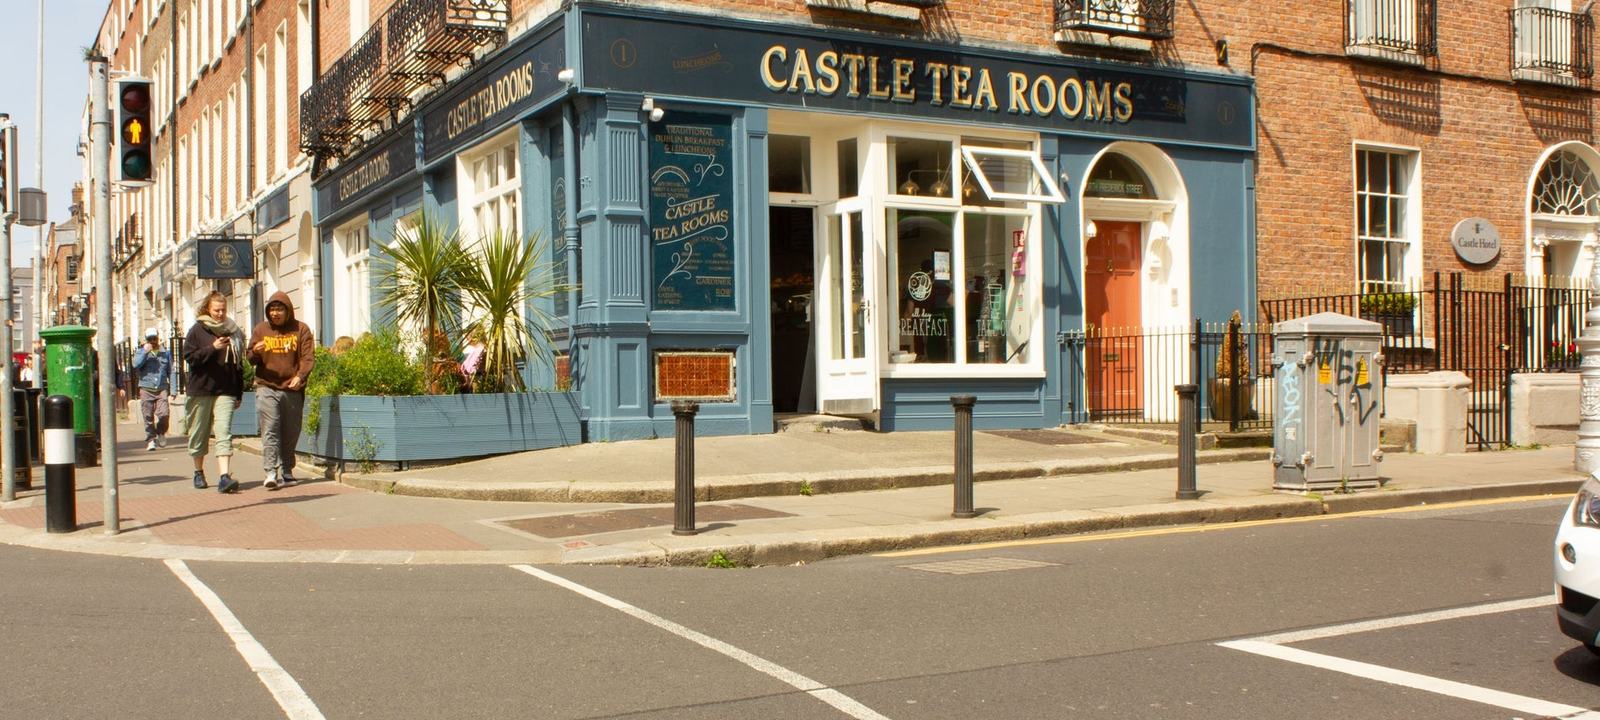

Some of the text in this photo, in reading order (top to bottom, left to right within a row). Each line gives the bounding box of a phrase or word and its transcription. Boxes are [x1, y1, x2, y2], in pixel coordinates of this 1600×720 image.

[759, 44, 1134, 123] CASTLE TEA ROOMS
[447, 94, 478, 139] CASTLE
[477, 84, 497, 121] TEA
[496, 61, 533, 112] ROOMS
[655, 134, 725, 146] DUBLIN BREAKFAST
[671, 144, 717, 154] LUNCHEONS
[339, 150, 390, 201] CASTLE TEA ROOMS
[665, 197, 715, 220] CASTLE
[652, 209, 728, 240] TEA ROOMS
[1458, 237, 1496, 249] Castle Hotel
